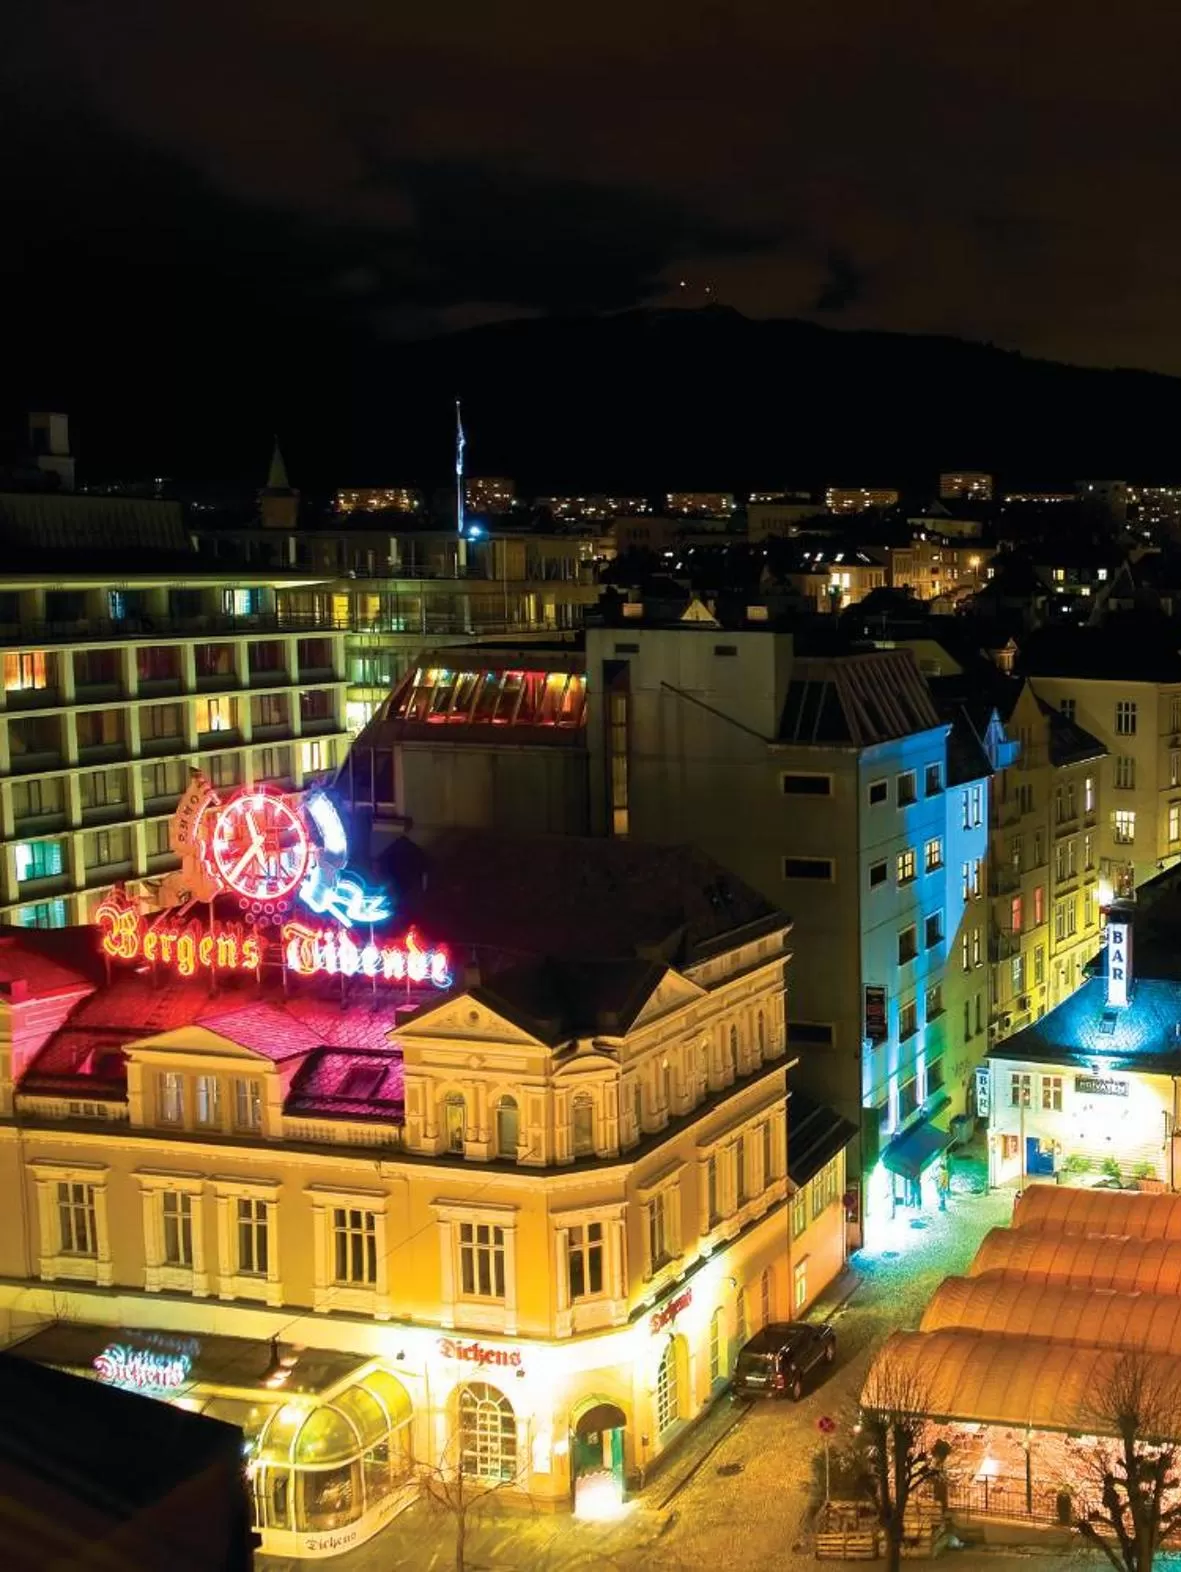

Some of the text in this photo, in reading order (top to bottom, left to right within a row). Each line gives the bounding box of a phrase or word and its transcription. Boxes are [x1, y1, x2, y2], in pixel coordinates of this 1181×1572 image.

[96, 904, 453, 988] Bergens Tidende
[1112, 930, 1123, 980] BAR
[436, 1338, 522, 1367] Dickens
